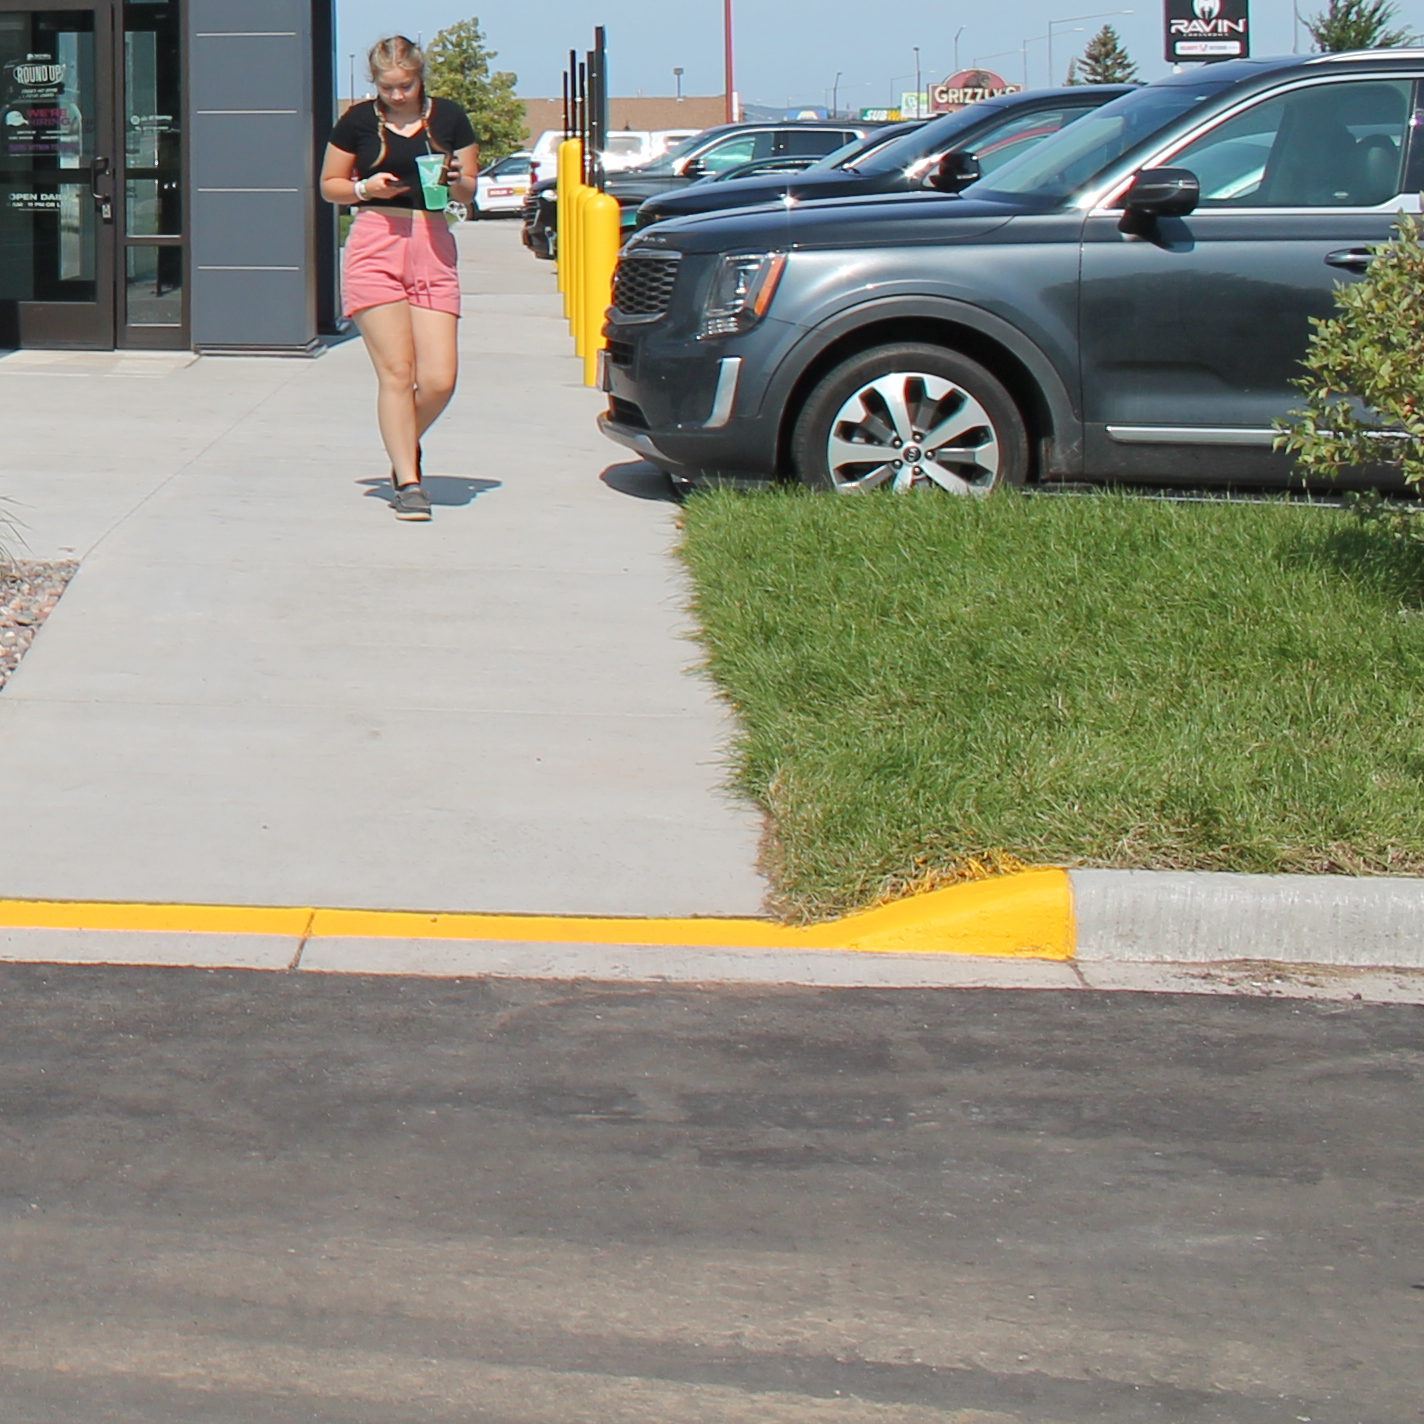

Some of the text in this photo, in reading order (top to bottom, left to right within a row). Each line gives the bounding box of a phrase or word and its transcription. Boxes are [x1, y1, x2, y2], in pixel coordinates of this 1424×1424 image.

[1170, 18, 1247, 33] RAVIN
[17, 64, 62, 83] ROUND UP
[8, 192, 38, 201] OPEN
